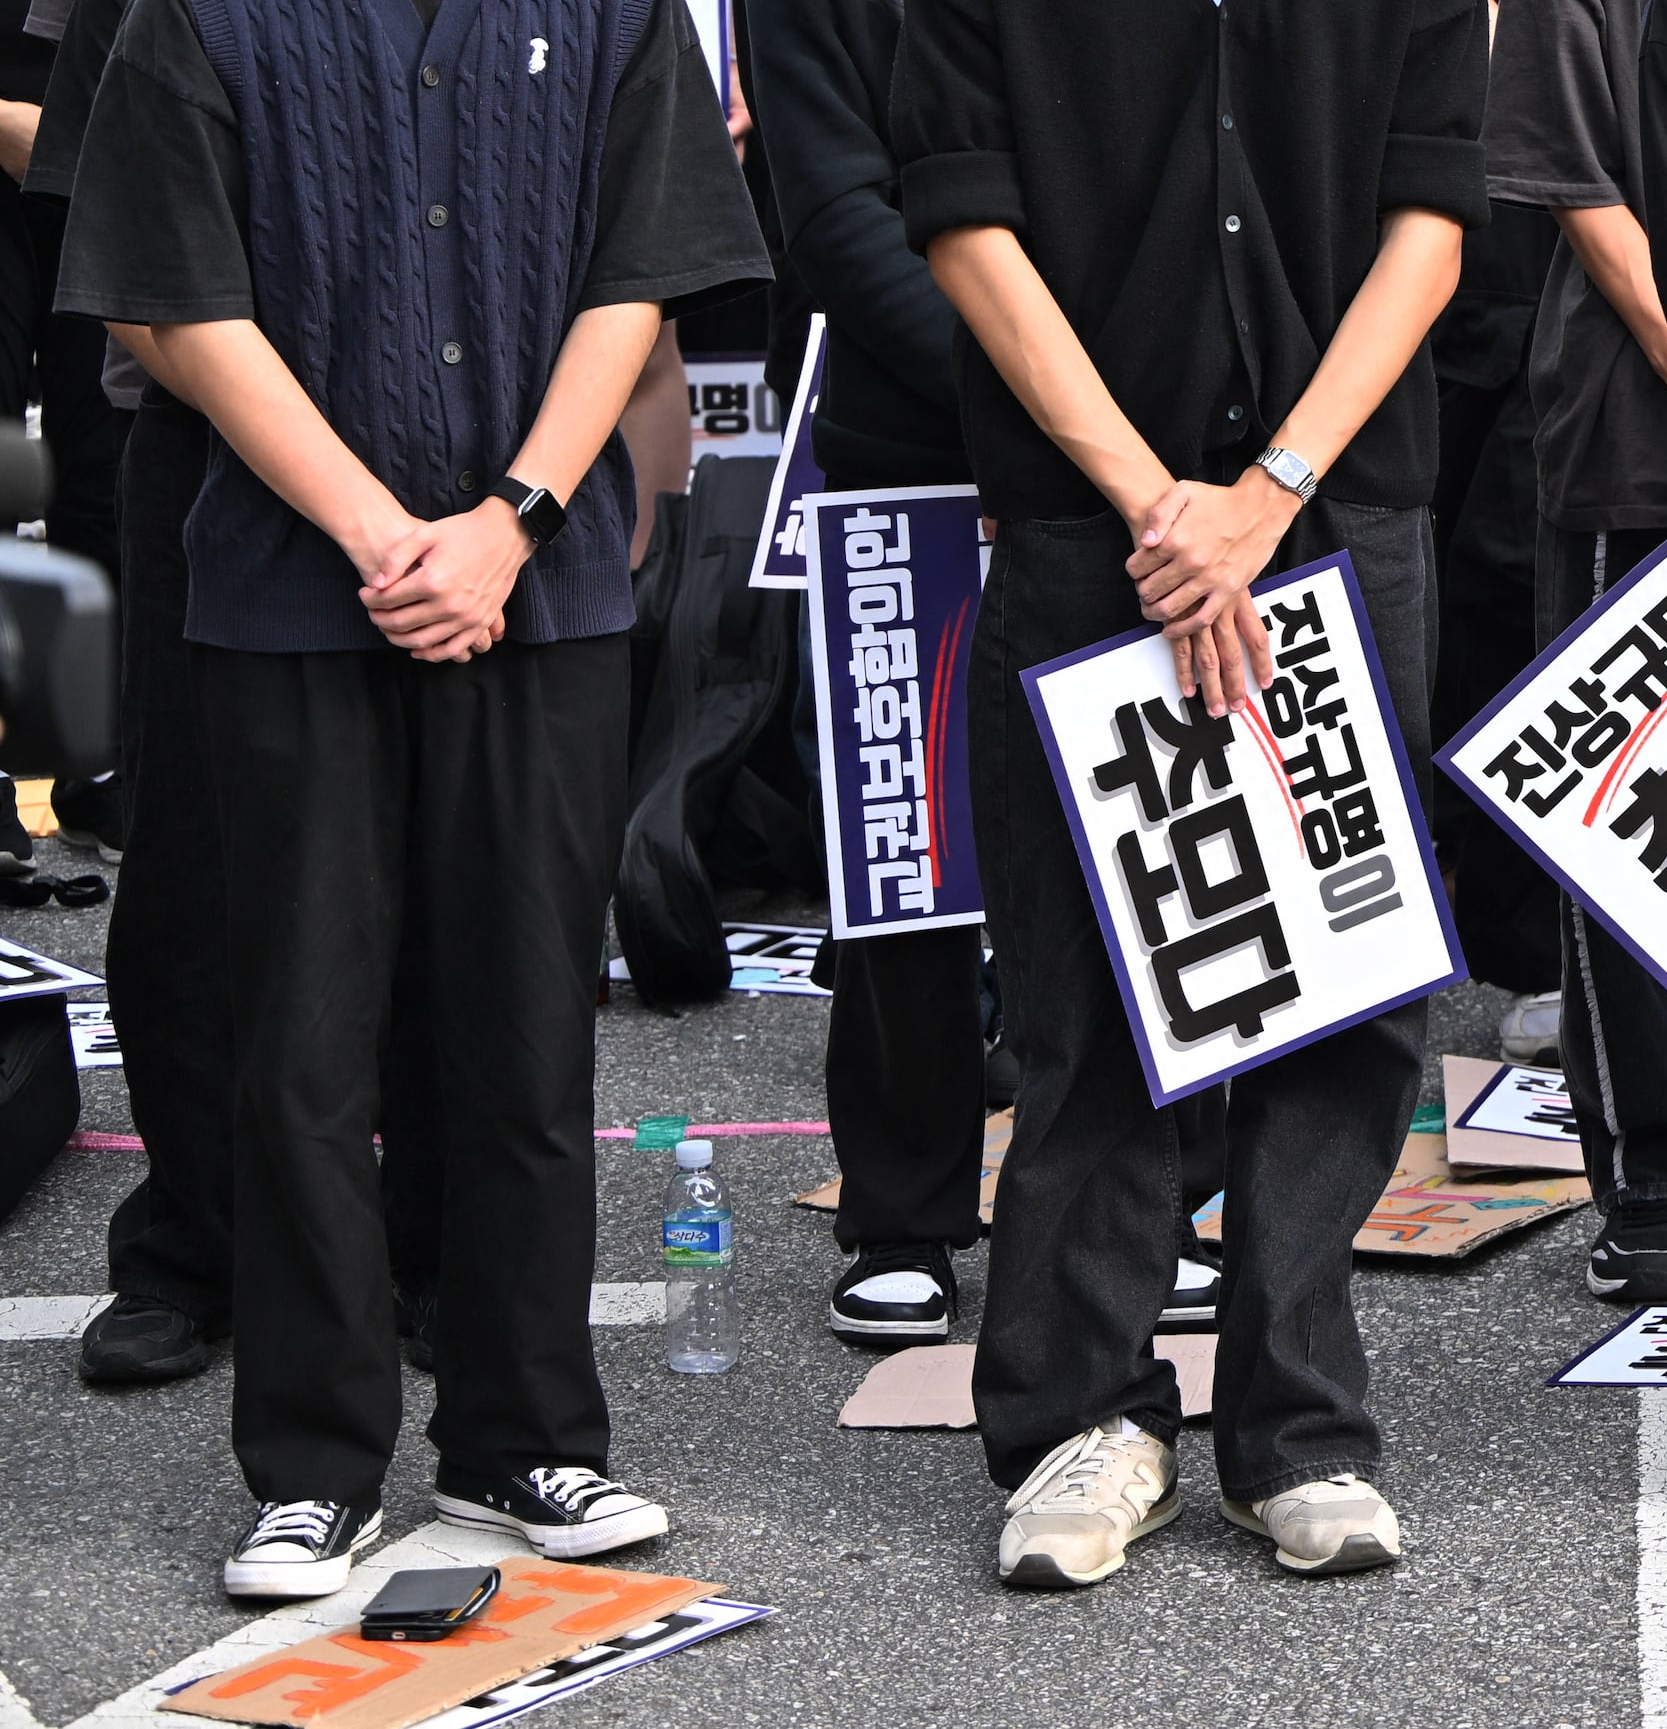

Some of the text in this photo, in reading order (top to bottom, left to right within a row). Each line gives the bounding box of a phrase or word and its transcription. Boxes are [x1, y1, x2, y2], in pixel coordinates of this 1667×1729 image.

[844, 508, 935, 918] 교권보호합의안
[1091, 696, 1303, 1048] 추모다
[1257, 591, 1404, 933] 진상규명이
